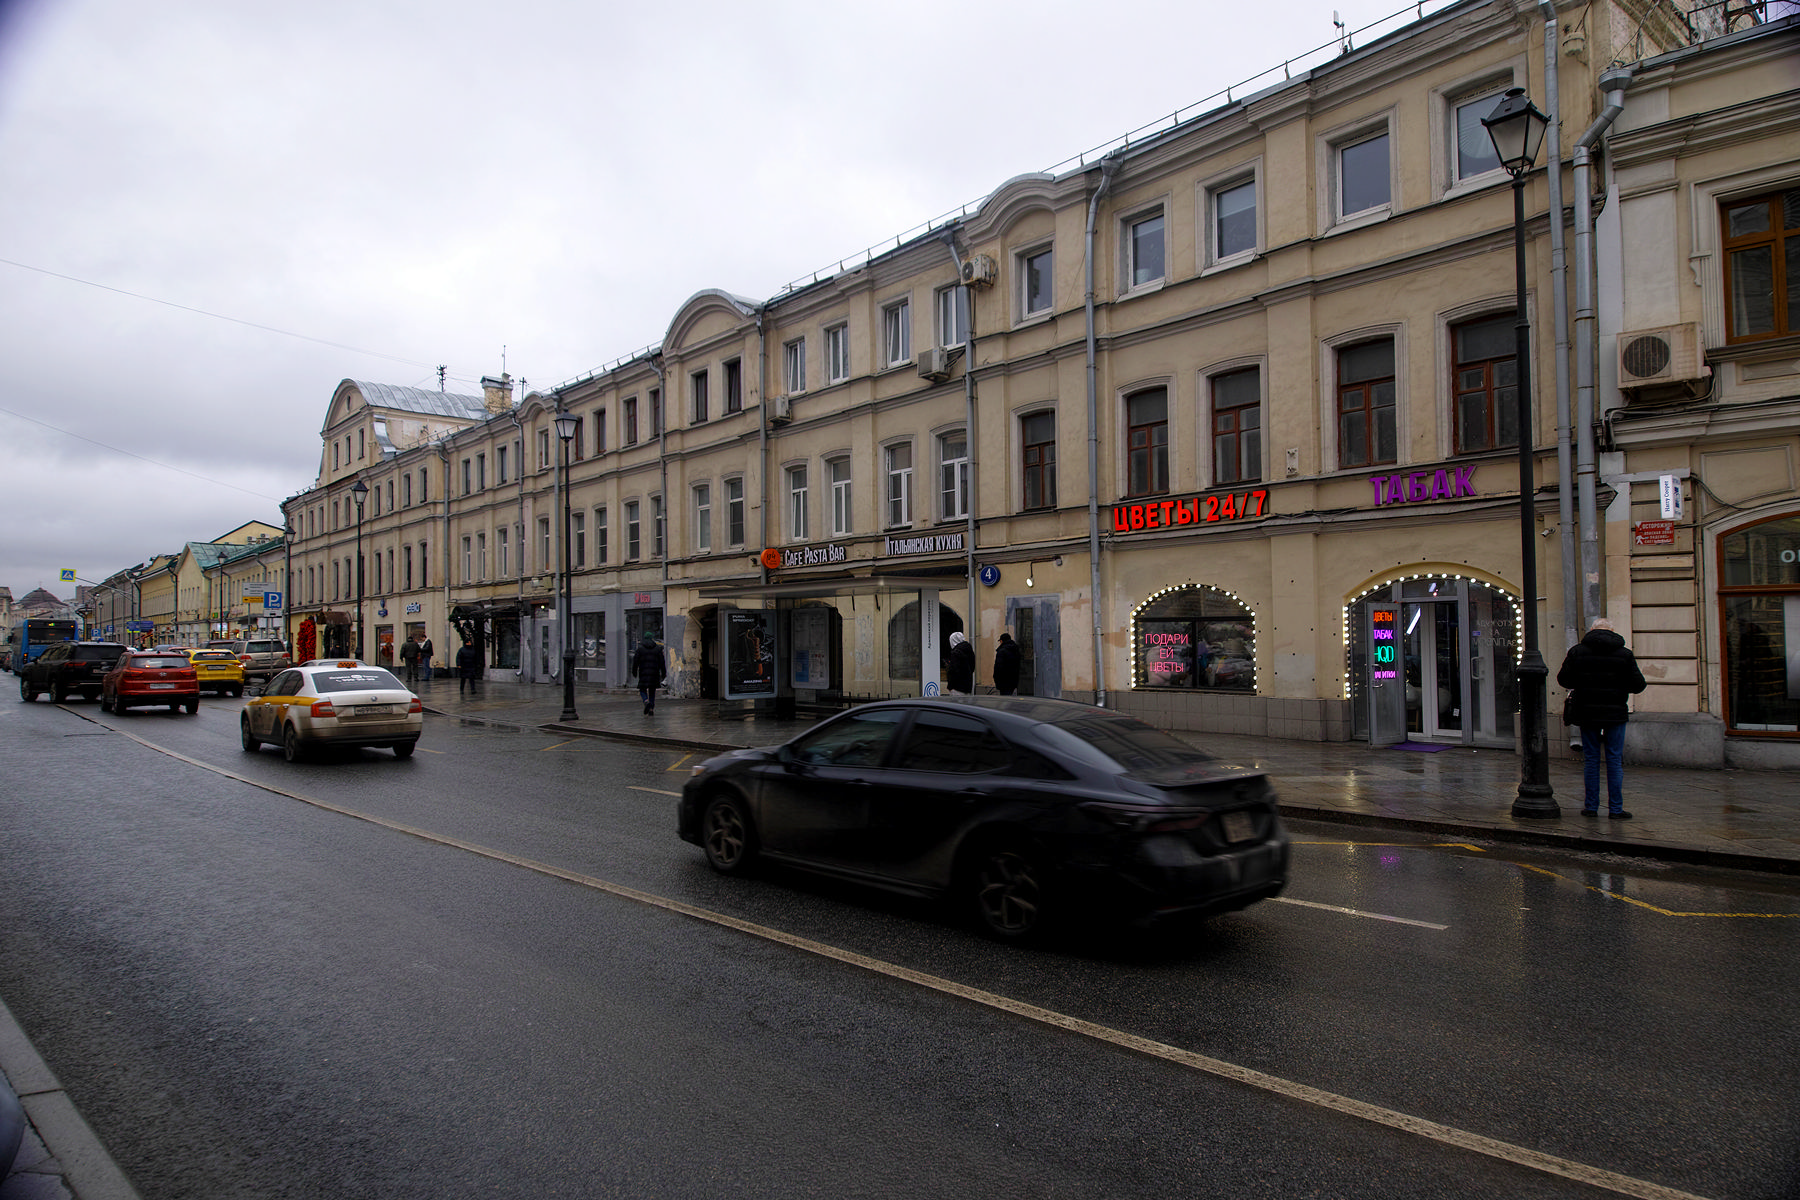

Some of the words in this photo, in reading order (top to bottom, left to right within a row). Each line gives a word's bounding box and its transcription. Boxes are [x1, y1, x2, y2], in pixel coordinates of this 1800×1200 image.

[1369, 465, 1478, 505] ТАБАК
[1114, 498, 1199, 532] ЦВЕТЫ
[1206, 490, 1267, 522] 24/7
[885, 536, 934, 556] ИТАЛЬЯНСКАЯ
[936, 534, 962, 551] КУХНЯ
[785, 549, 803, 566] CAFE
[804, 547, 828, 565] PASTA
[829, 544, 845, 562] BAR
[985, 567, 992, 580] 4
[1145, 633, 1188, 647] ПОДАРИ
[1374, 629, 1394, 640] ТАБАК
[1159, 646, 1174, 659] ЕЙ
[1149, 661, 1184, 674] ЦВЕТЫ
